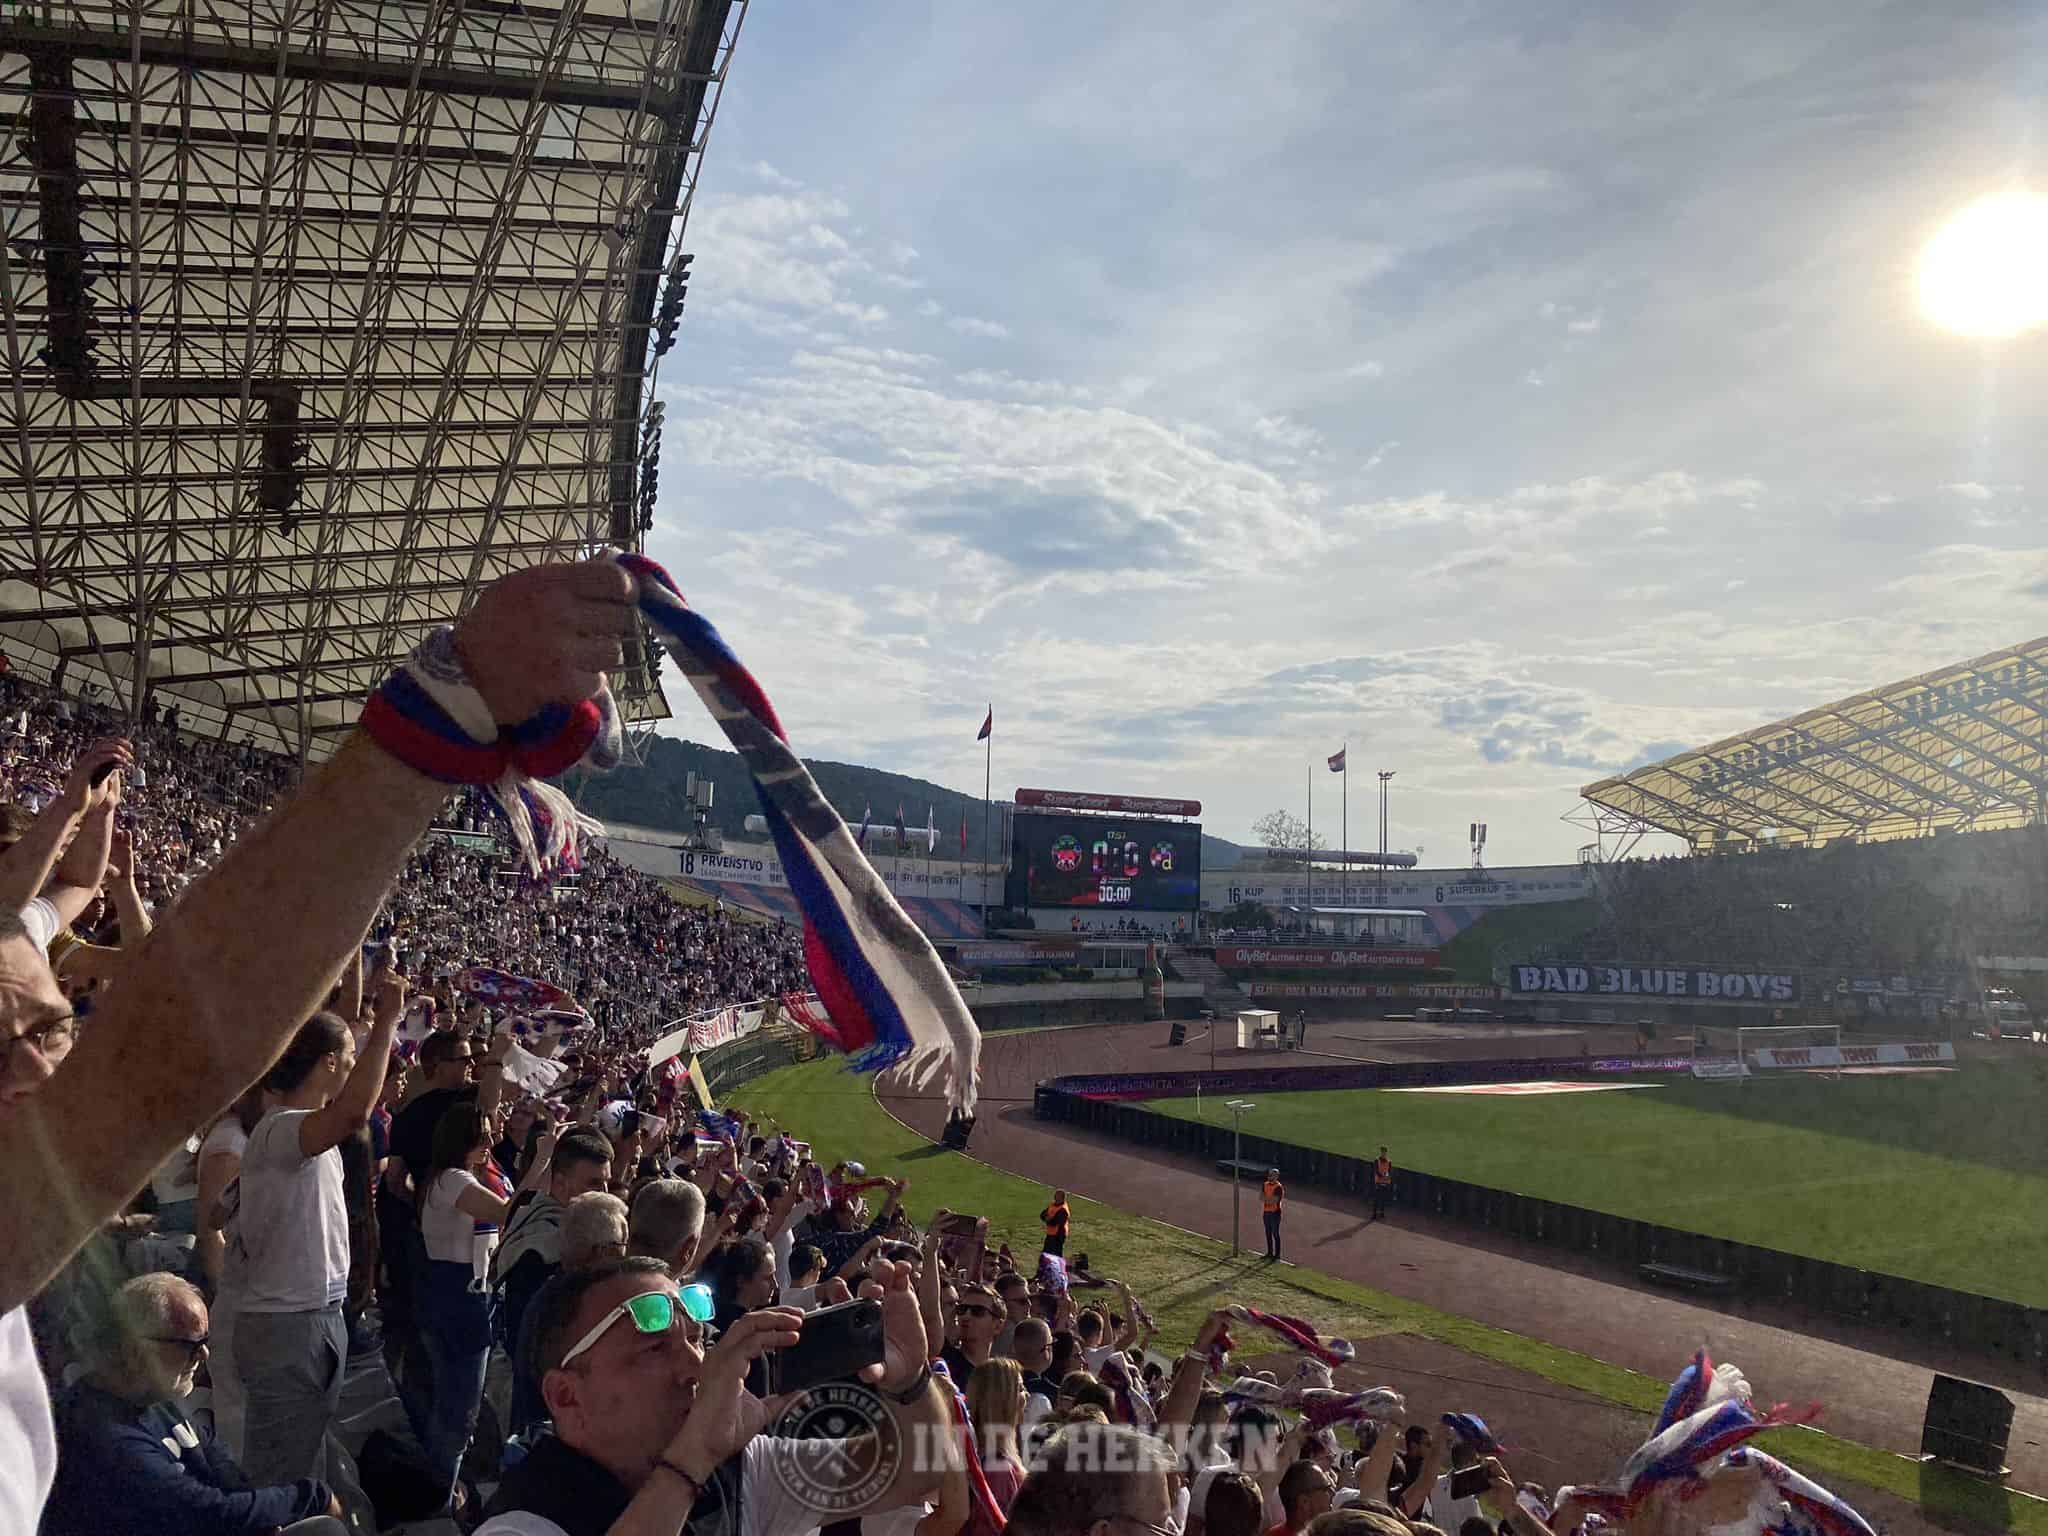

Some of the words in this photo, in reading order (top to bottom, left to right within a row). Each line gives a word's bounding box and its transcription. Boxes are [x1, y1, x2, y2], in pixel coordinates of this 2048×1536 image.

[680, 852, 694, 874] 18
[702, 855, 762, 871] PRVENSTVO
[1228, 887, 1241, 904] 16
[1245, 887, 1265, 897] KUP
[1435, 886, 1444, 903] 6
[1236, 949, 1271, 965] OlyBet
[1331, 951, 1369, 967] OlyBet
[1518, 966, 1589, 992] BAD
[1599, 967, 1688, 996] BLUE
[1696, 971, 1793, 1000] BOYS
